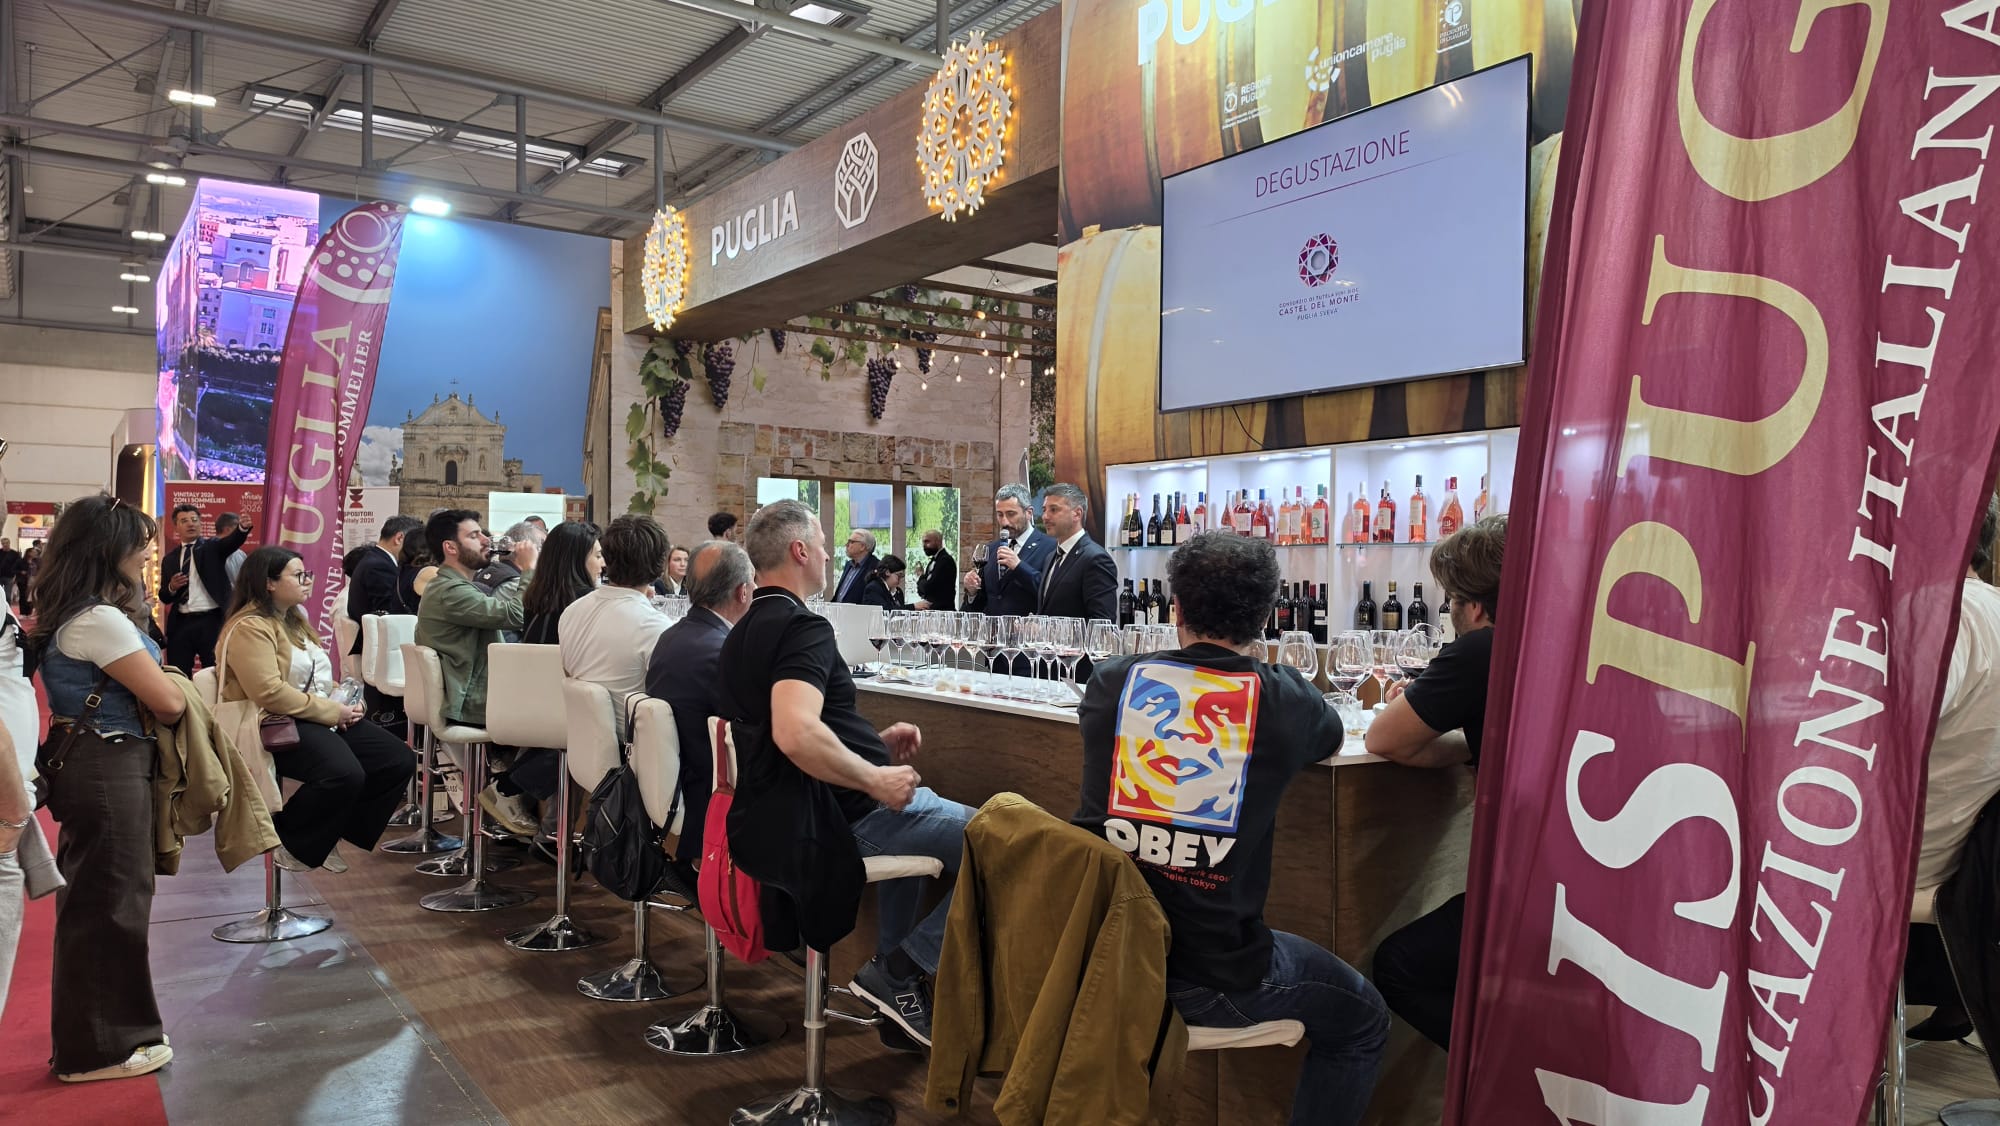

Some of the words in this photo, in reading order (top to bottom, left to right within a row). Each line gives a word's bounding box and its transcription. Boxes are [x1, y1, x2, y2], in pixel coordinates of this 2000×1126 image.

[1320, 32, 1394, 69] unioncamere
[1371, 36, 1406, 63] puglia
[1256, 129, 1410, 198] DEGUSTAZIONE
[712, 190, 799, 266] PUGLIA
[1278, 304, 1307, 316] CASTEL
[1310, 302, 1325, 310] DEL
[1329, 293, 1359, 306] MONTE
[1279, 298, 1307, 308] CONSORZIO
[1297, 312, 1318, 320] PUGLIA
[1319, 308, 1338, 317] SVEVA
[1103, 818, 1237, 868] OBEY
[1190, 877, 1217, 891] tokyo
